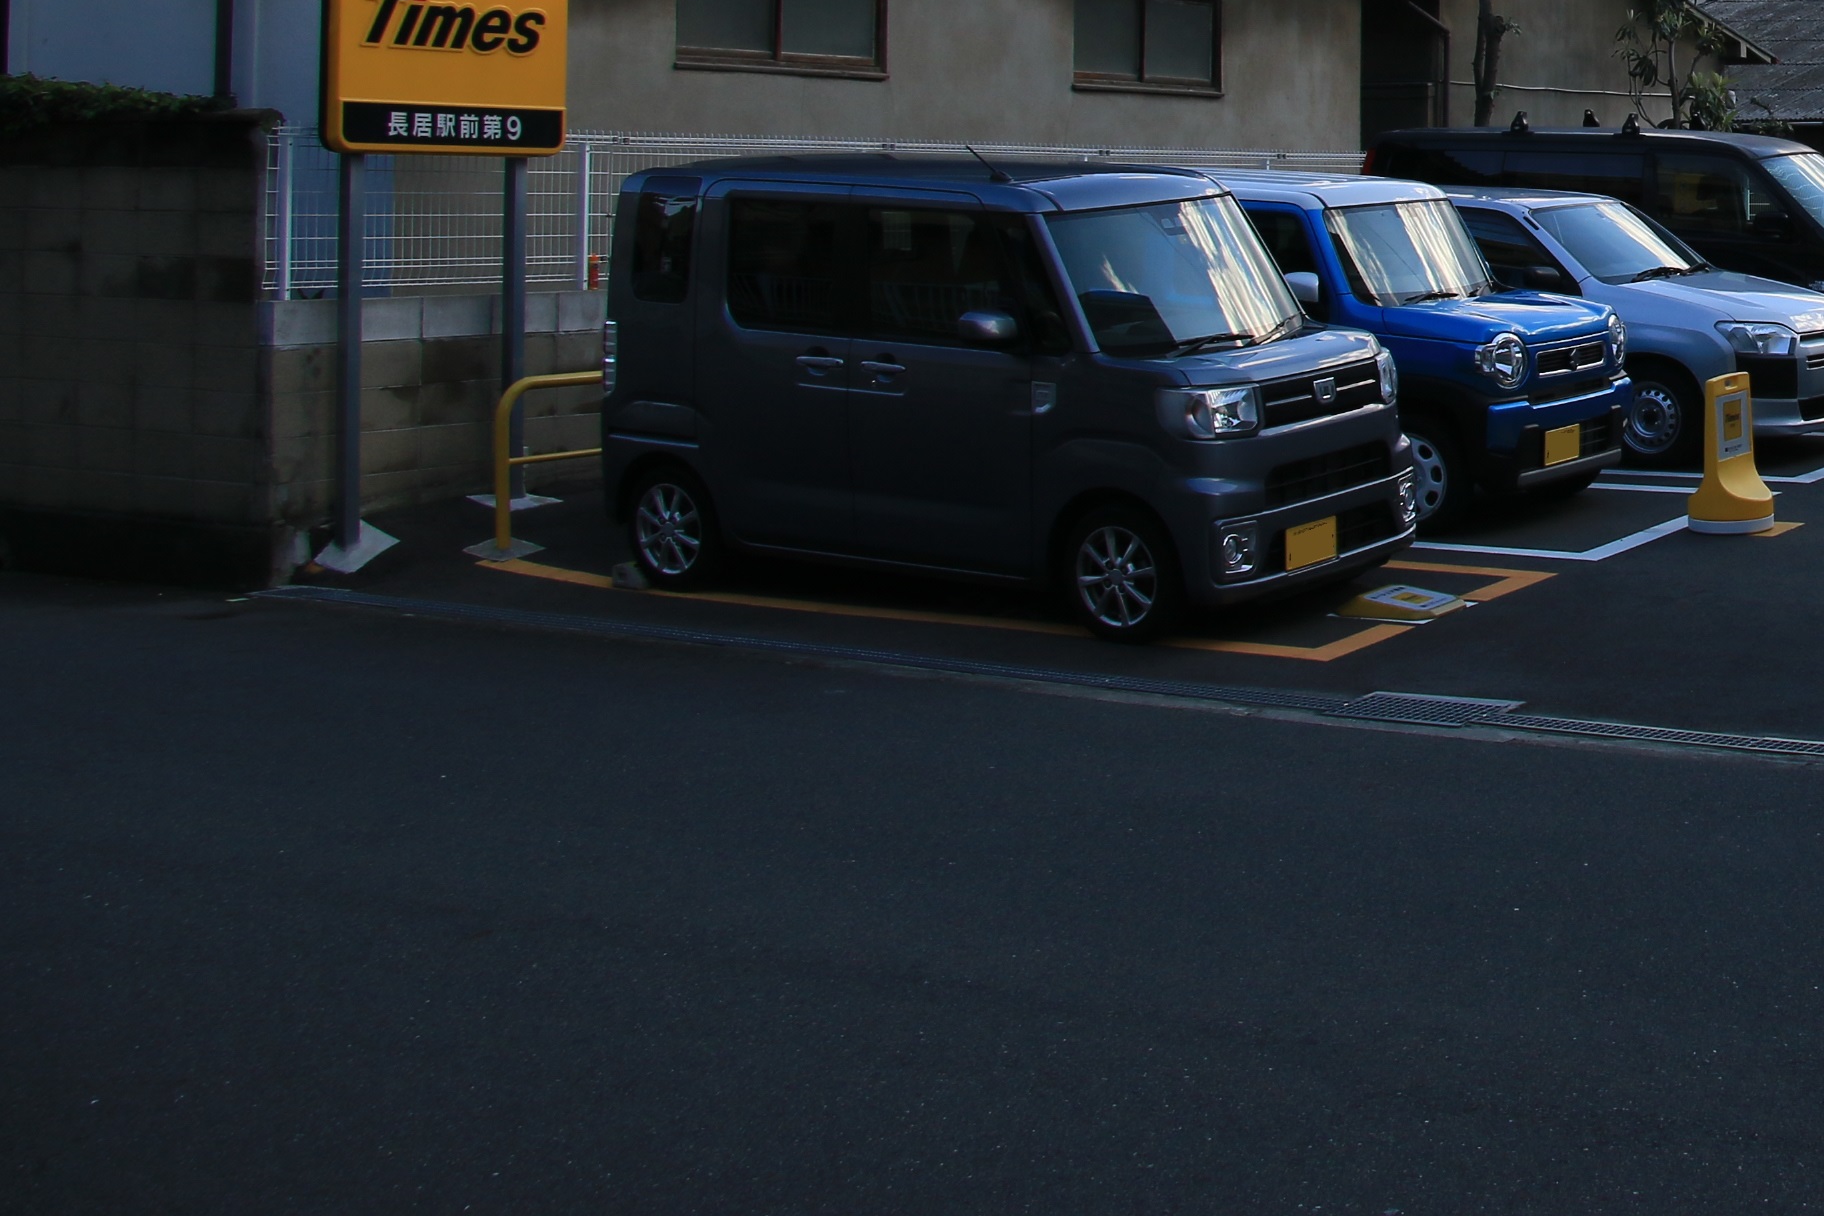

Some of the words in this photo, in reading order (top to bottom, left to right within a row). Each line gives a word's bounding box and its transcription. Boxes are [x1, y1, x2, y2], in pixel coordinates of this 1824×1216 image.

[388, 110, 522, 141] 長居駅前第9
